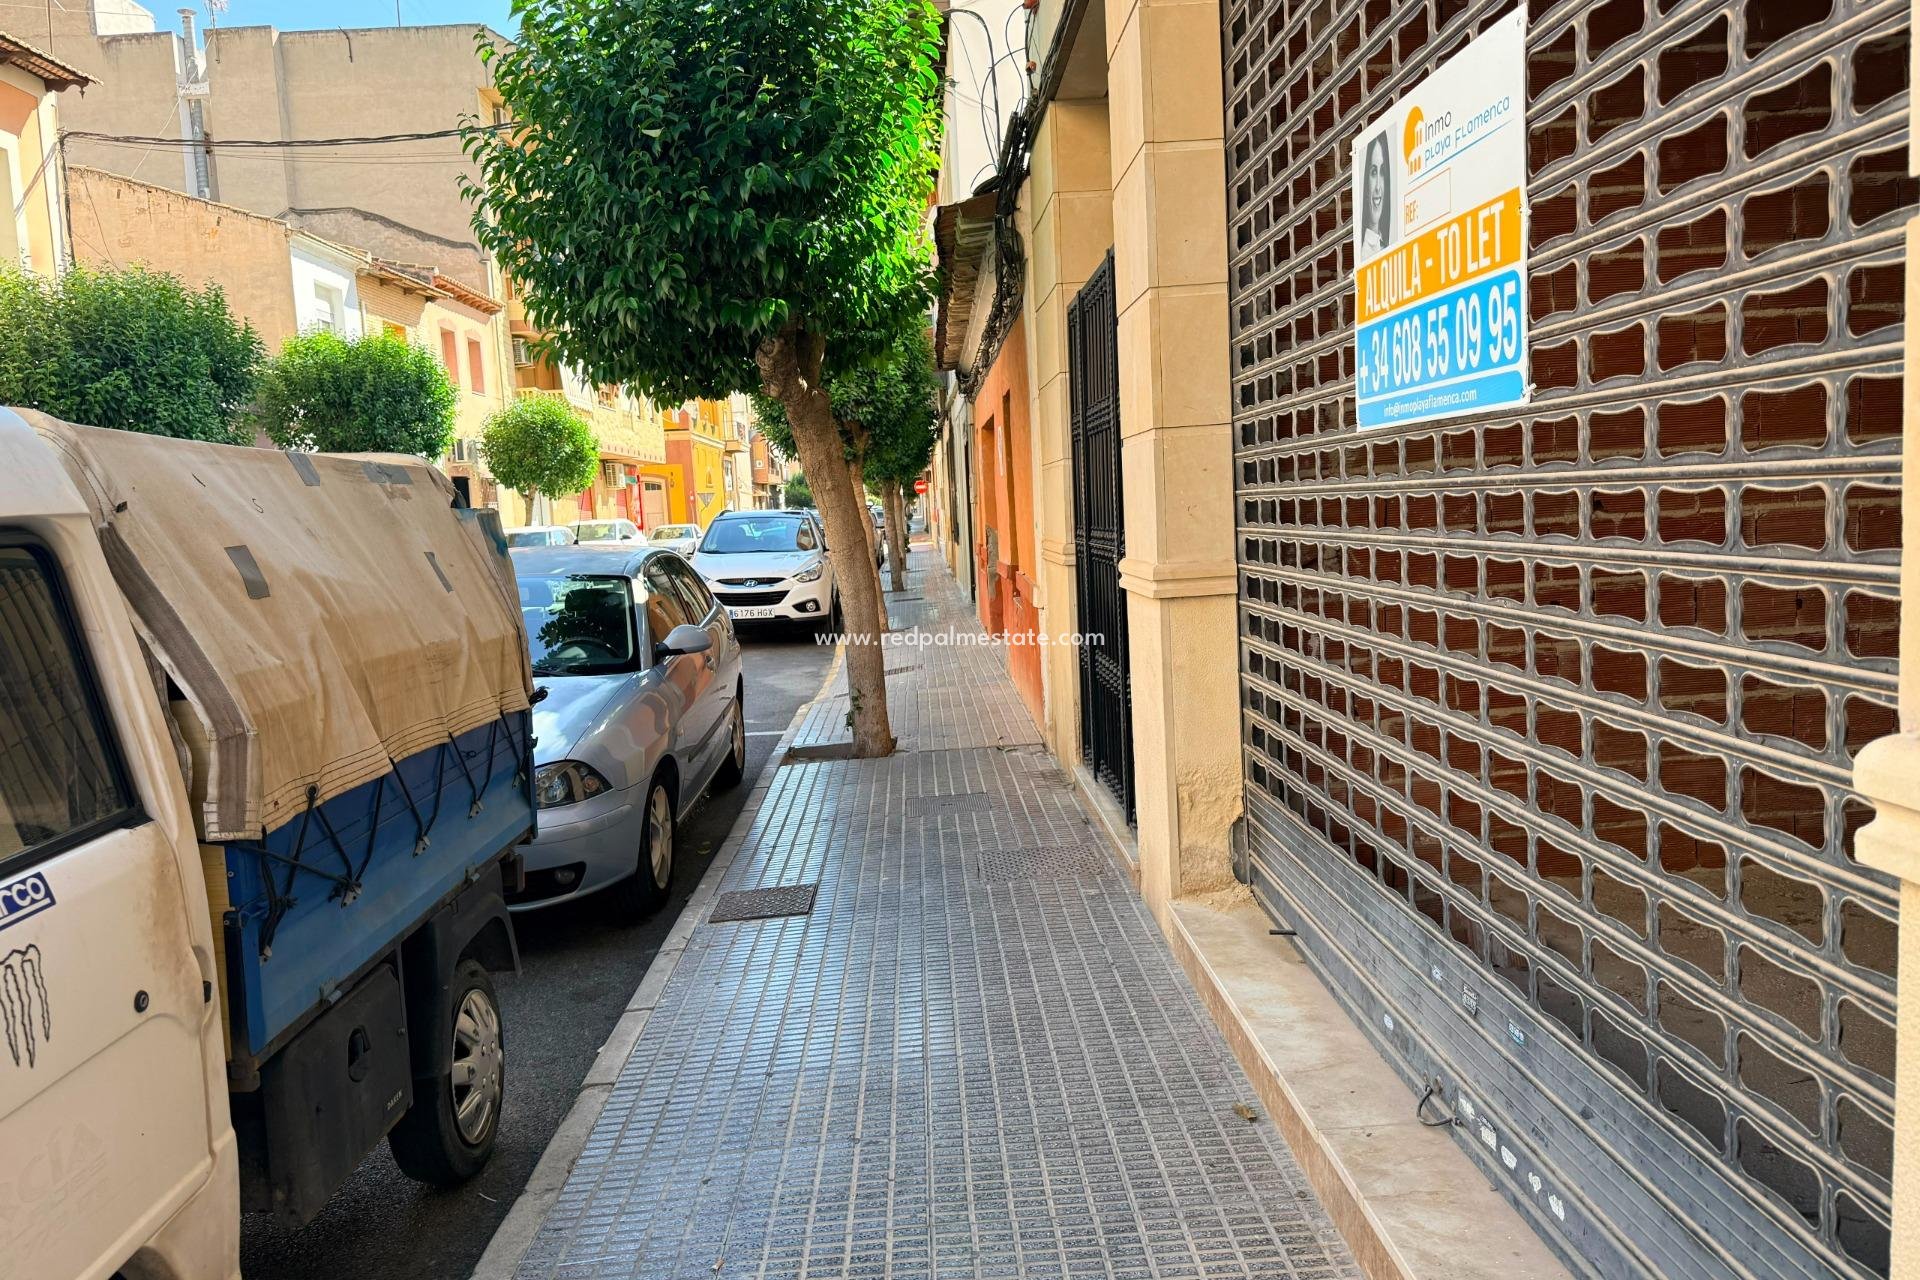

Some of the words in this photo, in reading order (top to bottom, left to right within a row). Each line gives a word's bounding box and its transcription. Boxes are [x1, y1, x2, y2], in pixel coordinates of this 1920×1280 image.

[1425, 111, 1452, 143] Inmo
[1405, 199, 1419, 225] REF:
[1365, 242, 1422, 316] ALQUILA
[1425, 257, 1433, 269] -
[1437, 222, 1461, 284] TO
[1466, 200, 1505, 274] LET
[1392, 314, 1422, 387] 608
[1427, 304, 1449, 378] 55
[1455, 292, 1481, 371] 09
[1488, 280, 1517, 364] 95
[1383, 388, 1478, 418] info@inmoplayaflamenca.com
[733, 608, 755, 618] 6176
[757, 608, 773, 617] HGX
